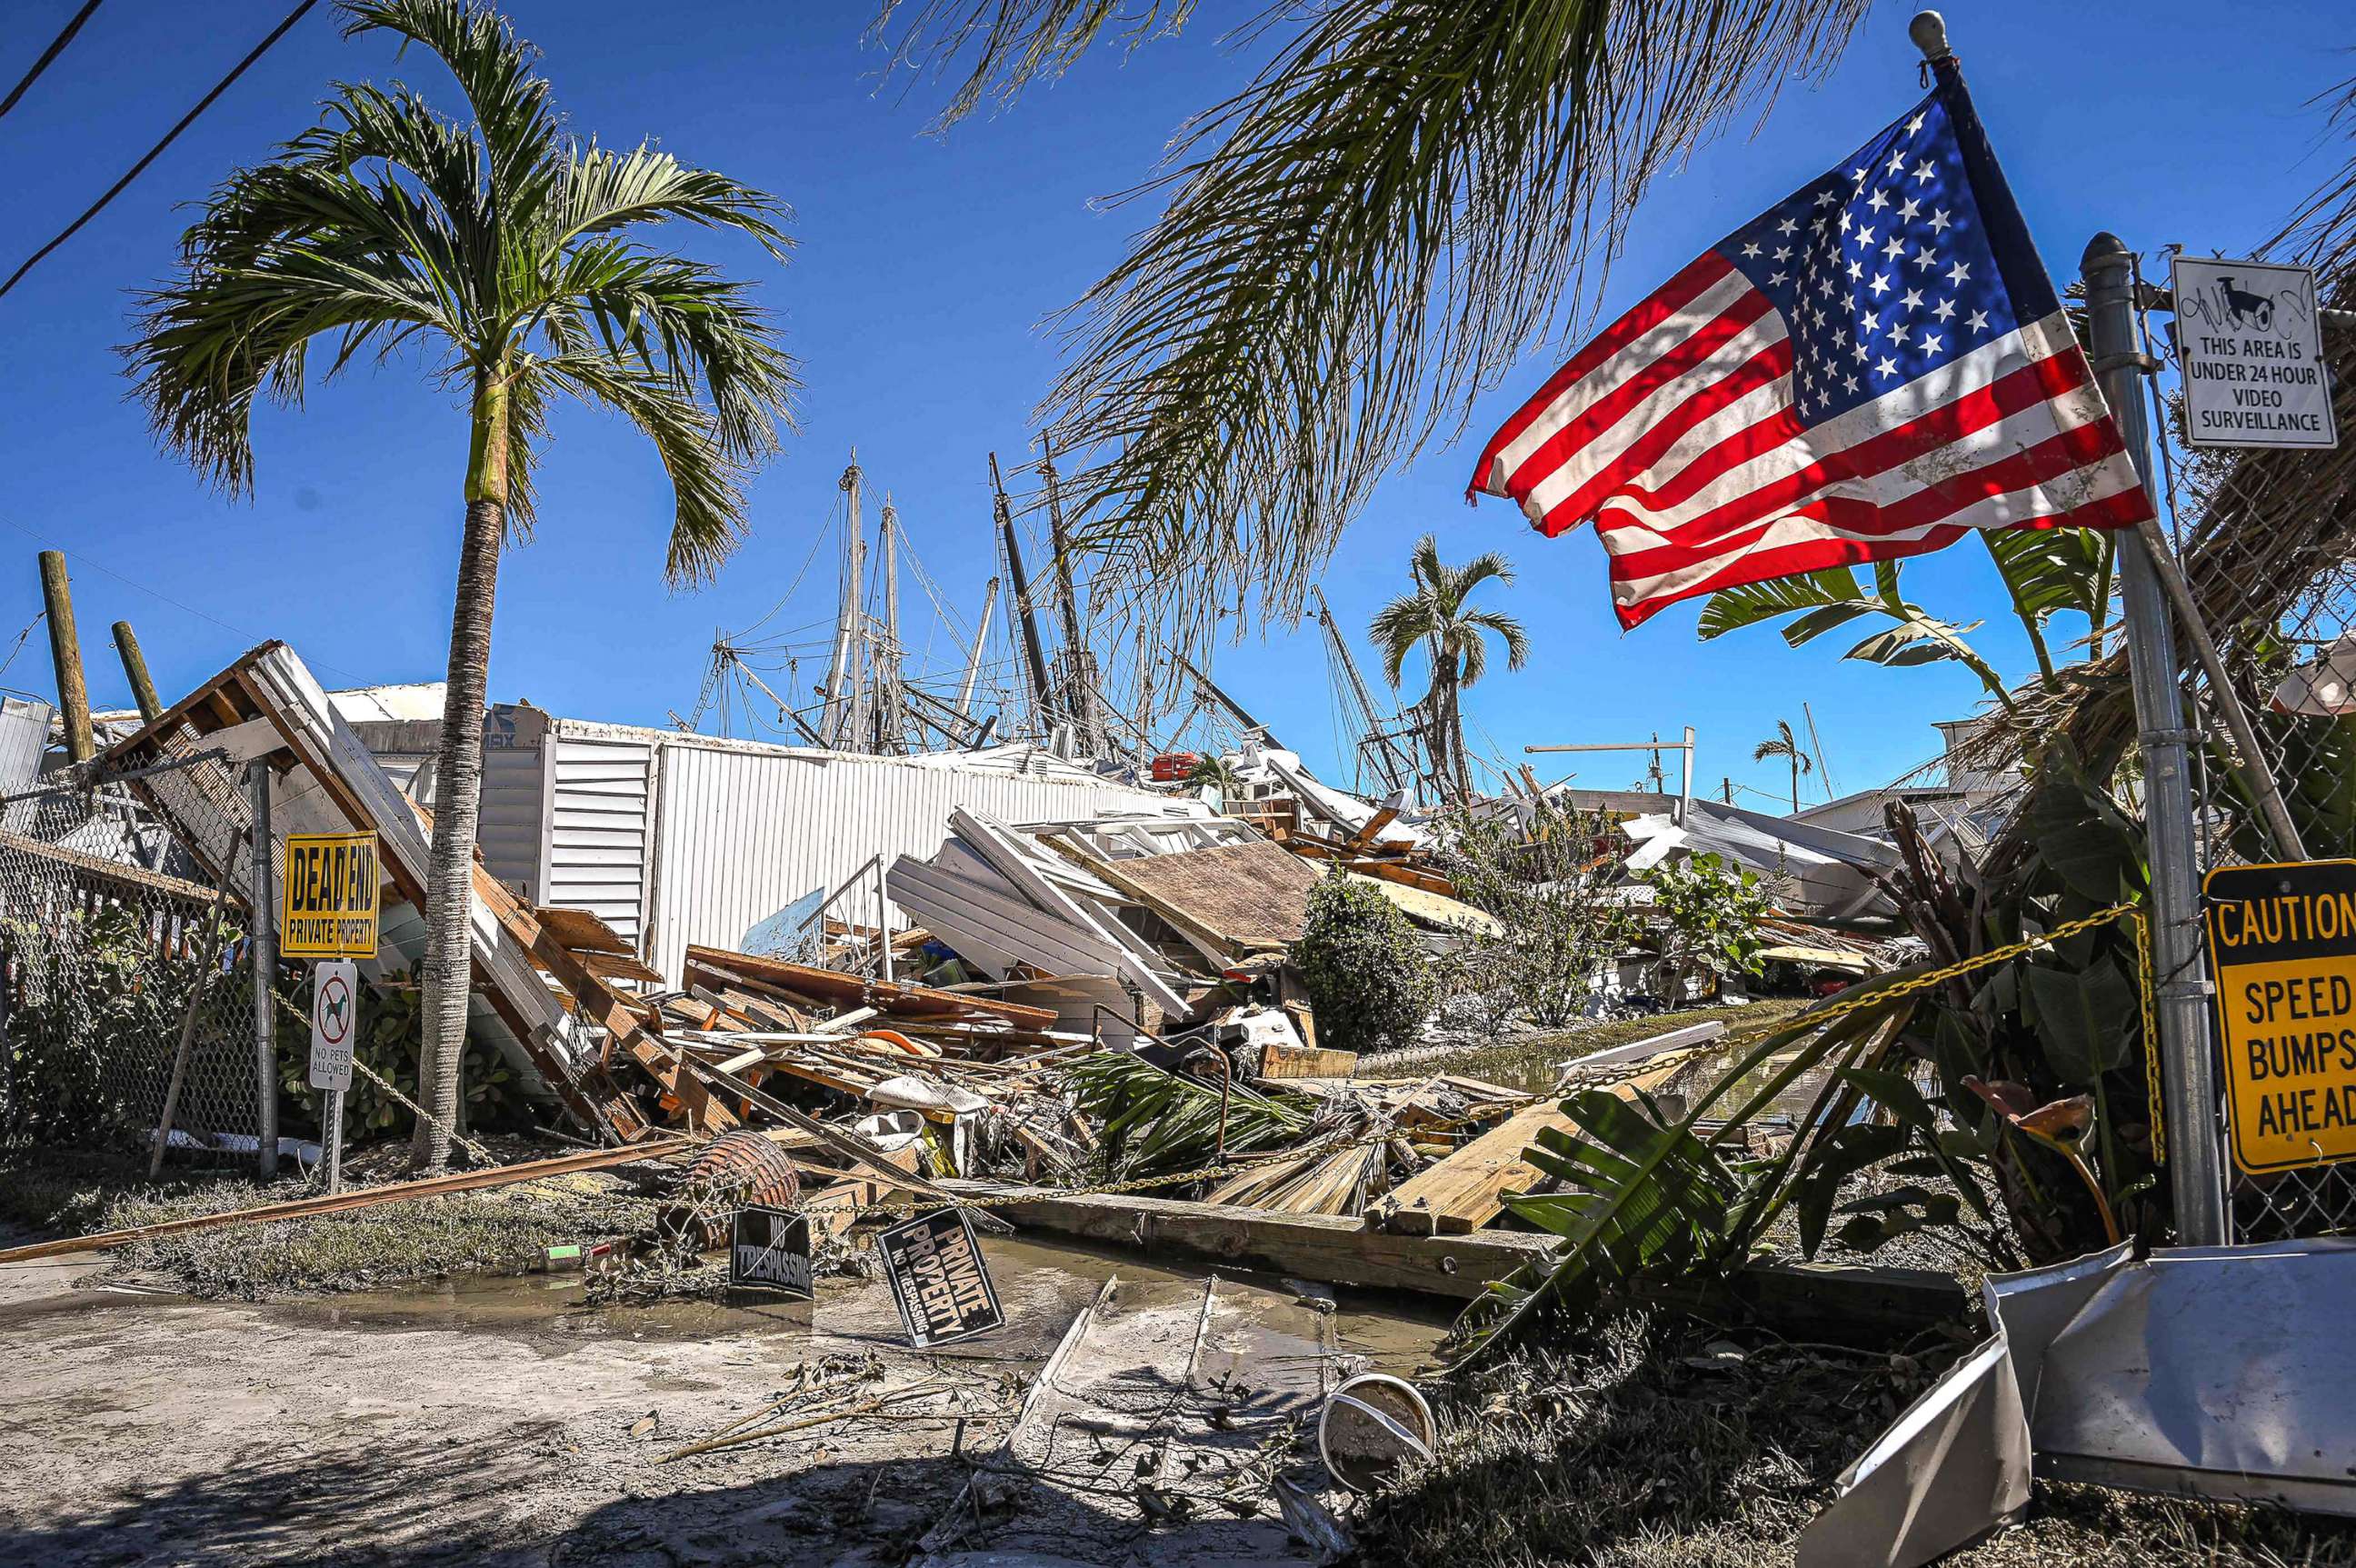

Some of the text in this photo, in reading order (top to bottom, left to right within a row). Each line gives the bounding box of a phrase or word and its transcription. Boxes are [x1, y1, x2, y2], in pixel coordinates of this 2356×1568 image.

[2200, 336, 2301, 360] THIS AREA IS
[2191, 362, 2317, 385] UNDER 24 HOUR
[2232, 388, 2282, 407] VIDEO
[2201, 410, 2321, 431] SURVEILLANCE
[292, 844, 373, 912] DEAD END
[290, 918, 372, 944] PRIVATE PROPERTY
[2218, 894, 2356, 947] CAUTION
[2245, 975, 2351, 1024] SPEED
[313, 1061, 349, 1076] ALLOWED
[314, 1047, 349, 1063] NO PETS
[2247, 1028, 2356, 1082] BUMPS
[770, 1214, 785, 1248] NO
[737, 1244, 811, 1287] TRESPASSING
[891, 1248, 908, 1266] NO
[934, 1225, 991, 1318] PRIVATE
[902, 1223, 965, 1335] PROPERTY
